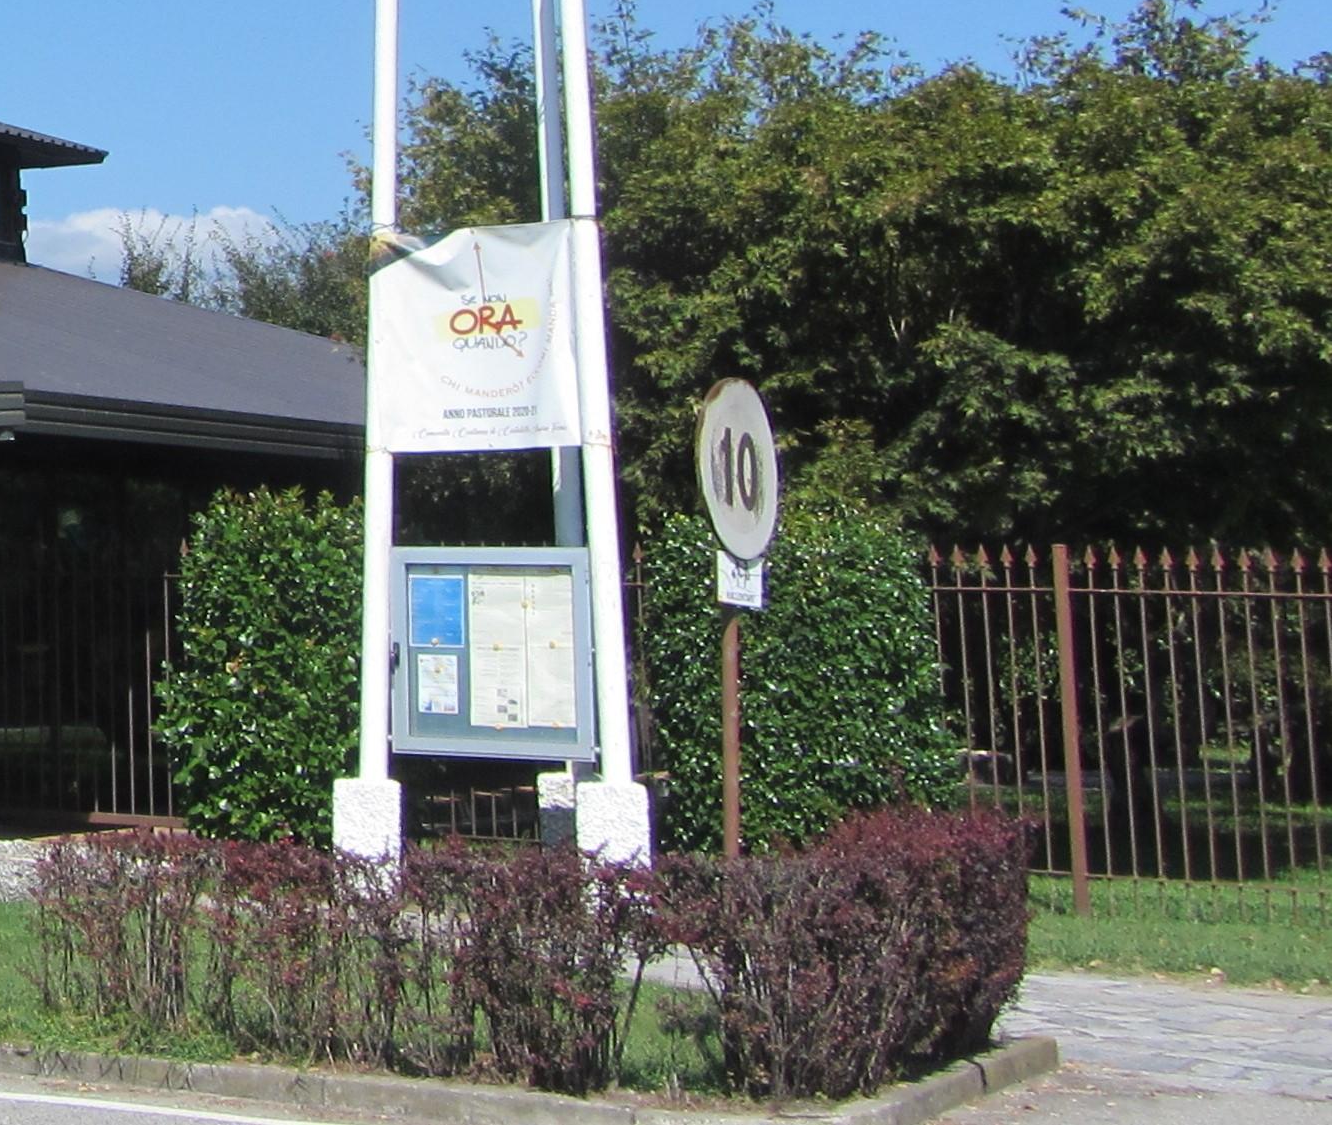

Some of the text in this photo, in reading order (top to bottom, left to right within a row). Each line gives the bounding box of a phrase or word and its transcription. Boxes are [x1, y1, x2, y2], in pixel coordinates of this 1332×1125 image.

[449, 303, 523, 335] ORA
[452, 331, 528, 352] QUANDO?
[439, 375, 461, 391] CHI
[442, 408, 465, 419] ANNO
[466, 406, 511, 419] PASTORALE
[719, 427, 758, 512] 10
